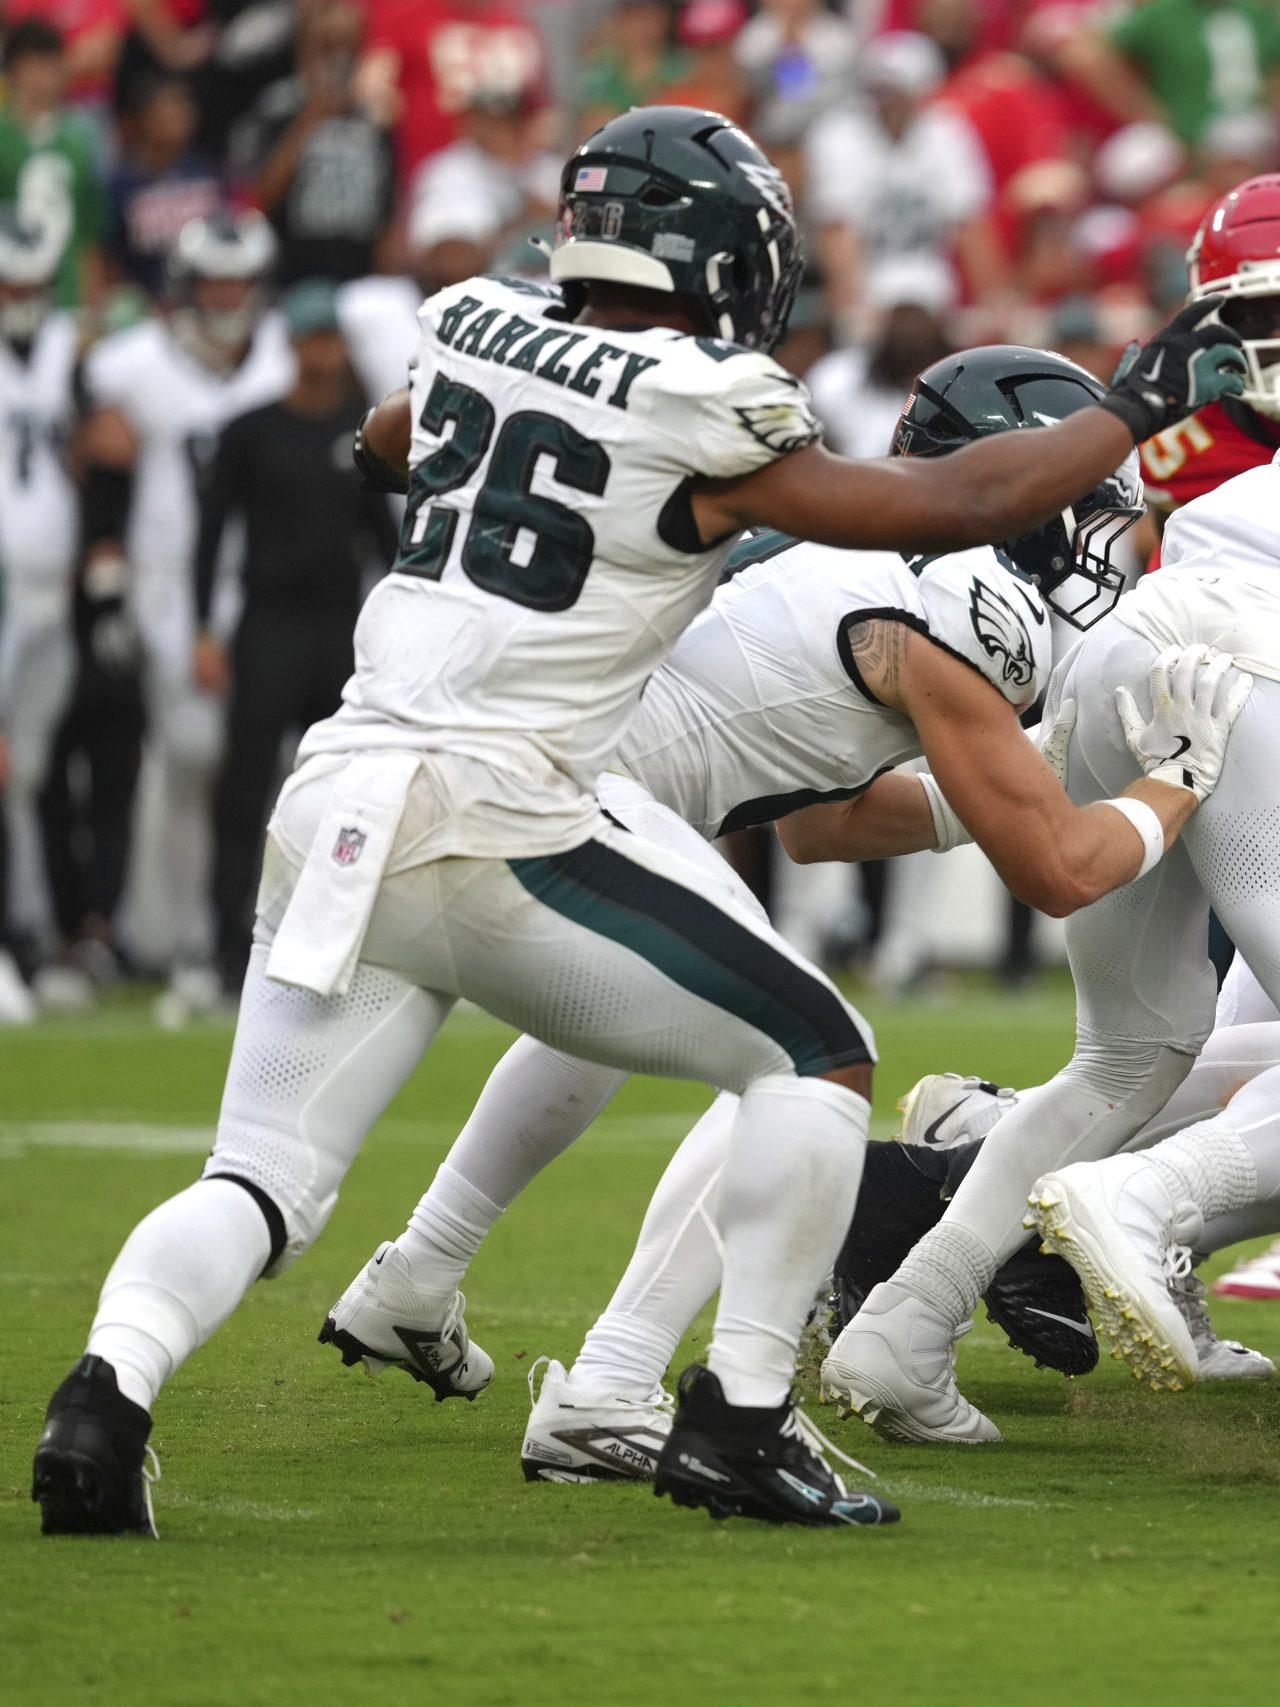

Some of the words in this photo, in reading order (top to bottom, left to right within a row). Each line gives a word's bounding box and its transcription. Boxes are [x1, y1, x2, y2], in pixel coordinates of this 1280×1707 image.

[436, 296, 661, 410] BARKLEY
[392, 371, 612, 613] 26
[603, 1442, 653, 1472] ALPHA
